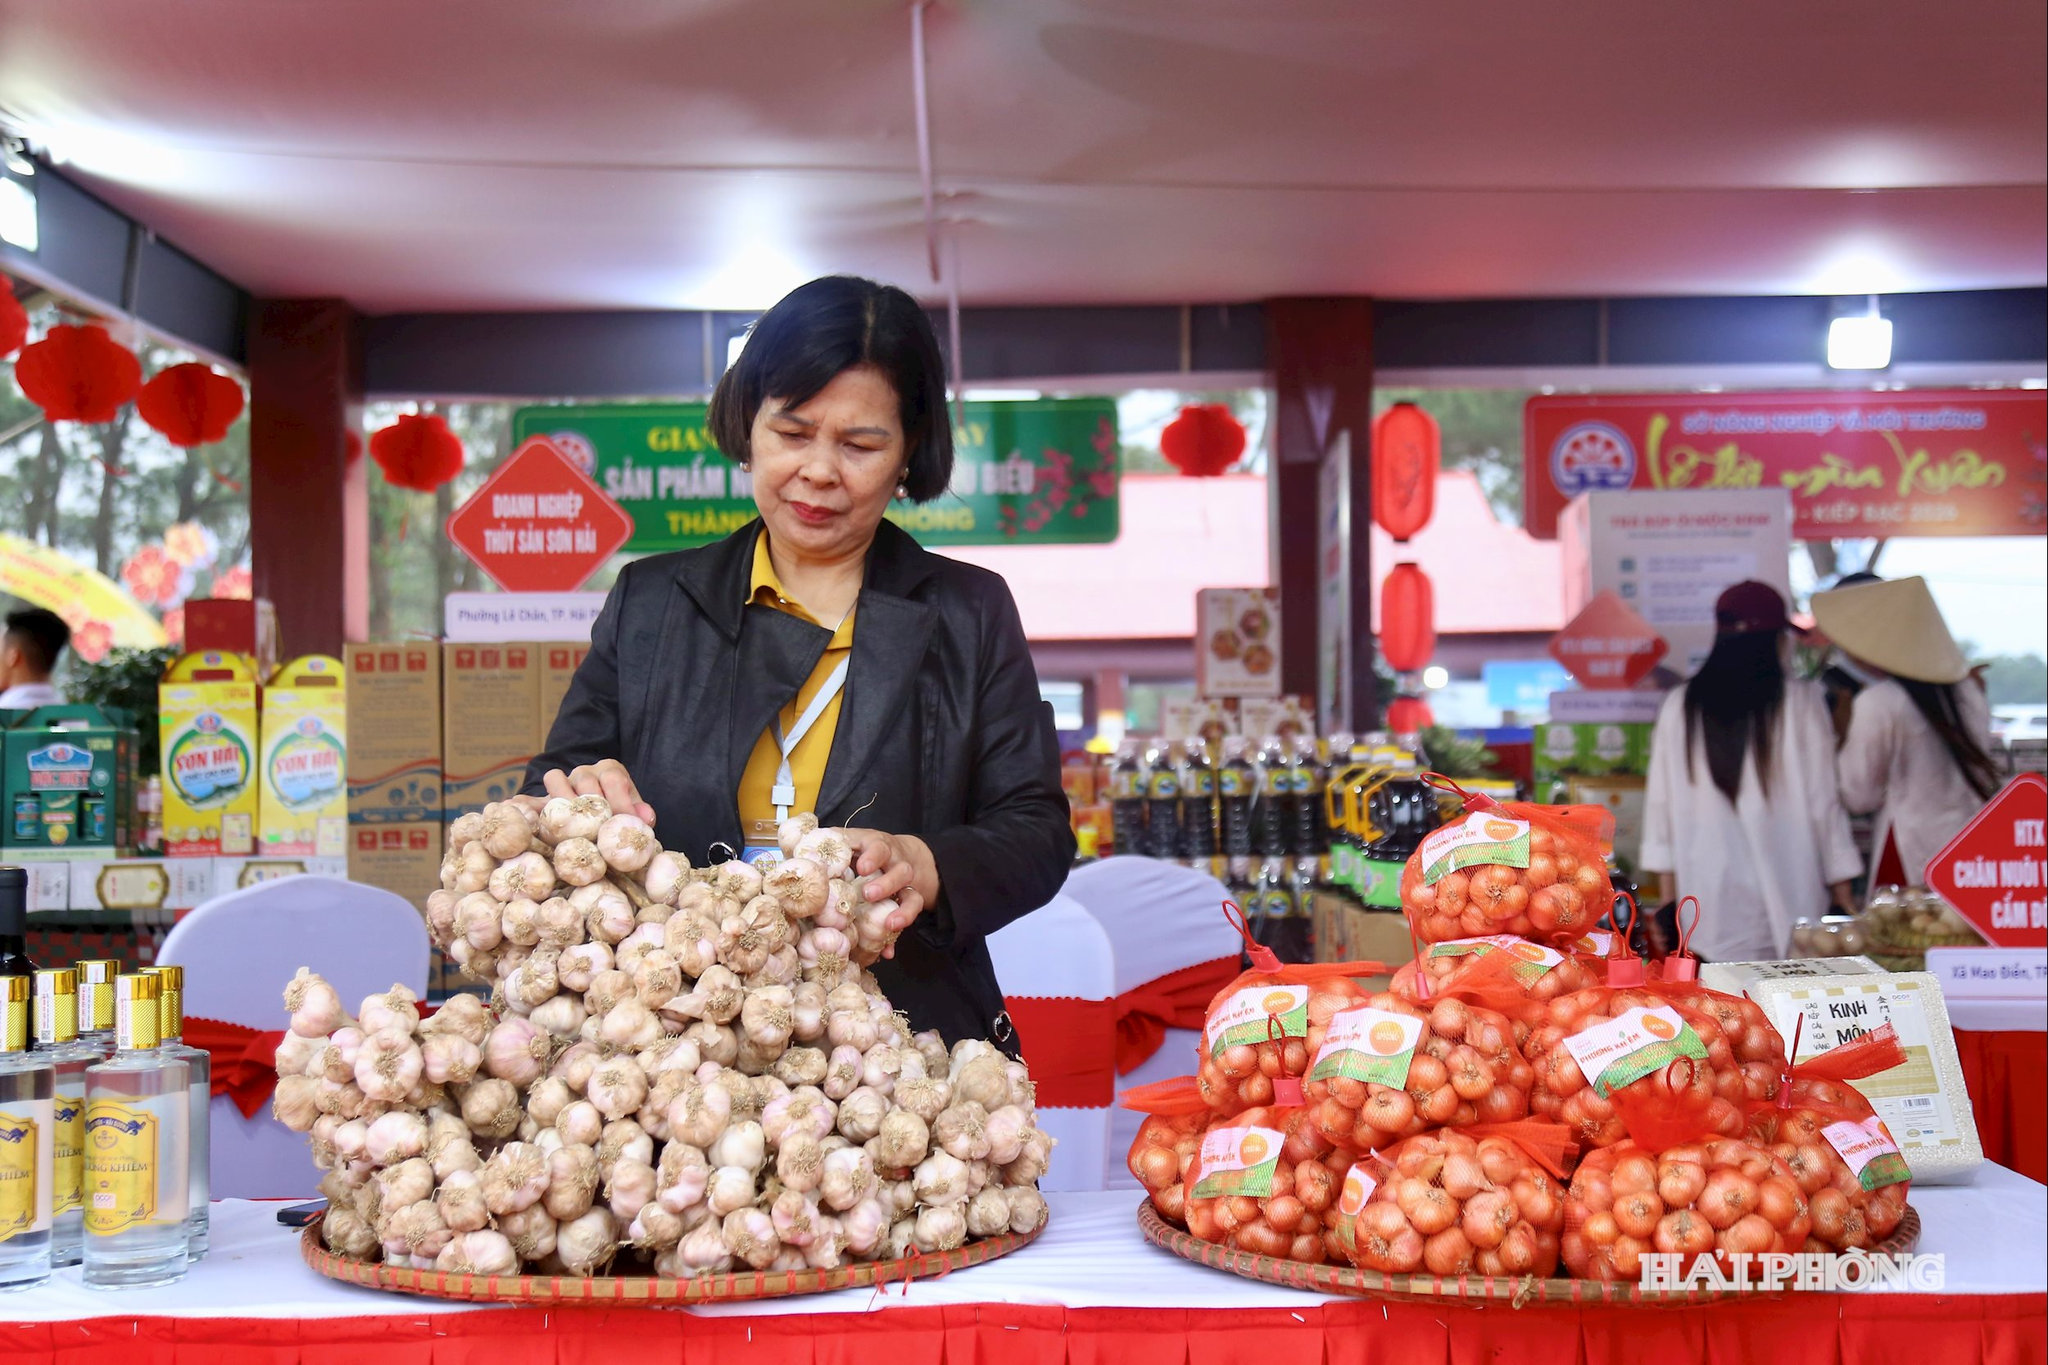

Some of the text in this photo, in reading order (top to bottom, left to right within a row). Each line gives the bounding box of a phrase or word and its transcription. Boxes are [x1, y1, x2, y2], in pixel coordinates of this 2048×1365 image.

[604, 456, 652, 498] SẢN
[658, 453, 725, 499] PHẨM
[981, 450, 1035, 495] BIỂU
[492, 489, 584, 522] DOANH NGHIỆP
[517, 521, 544, 553] SẢN
[546, 527, 572, 553] SƠN
[575, 521, 596, 553] HẢI
[2014, 819, 2045, 847] HTX
[1953, 855, 1997, 888] CHĂN
[1999, 854, 2039, 888] NUÔI
[1991, 890, 2028, 928] CẨM
[1828, 1000, 1868, 1018] KINH
[1836, 1024, 1874, 1046] MÔN
